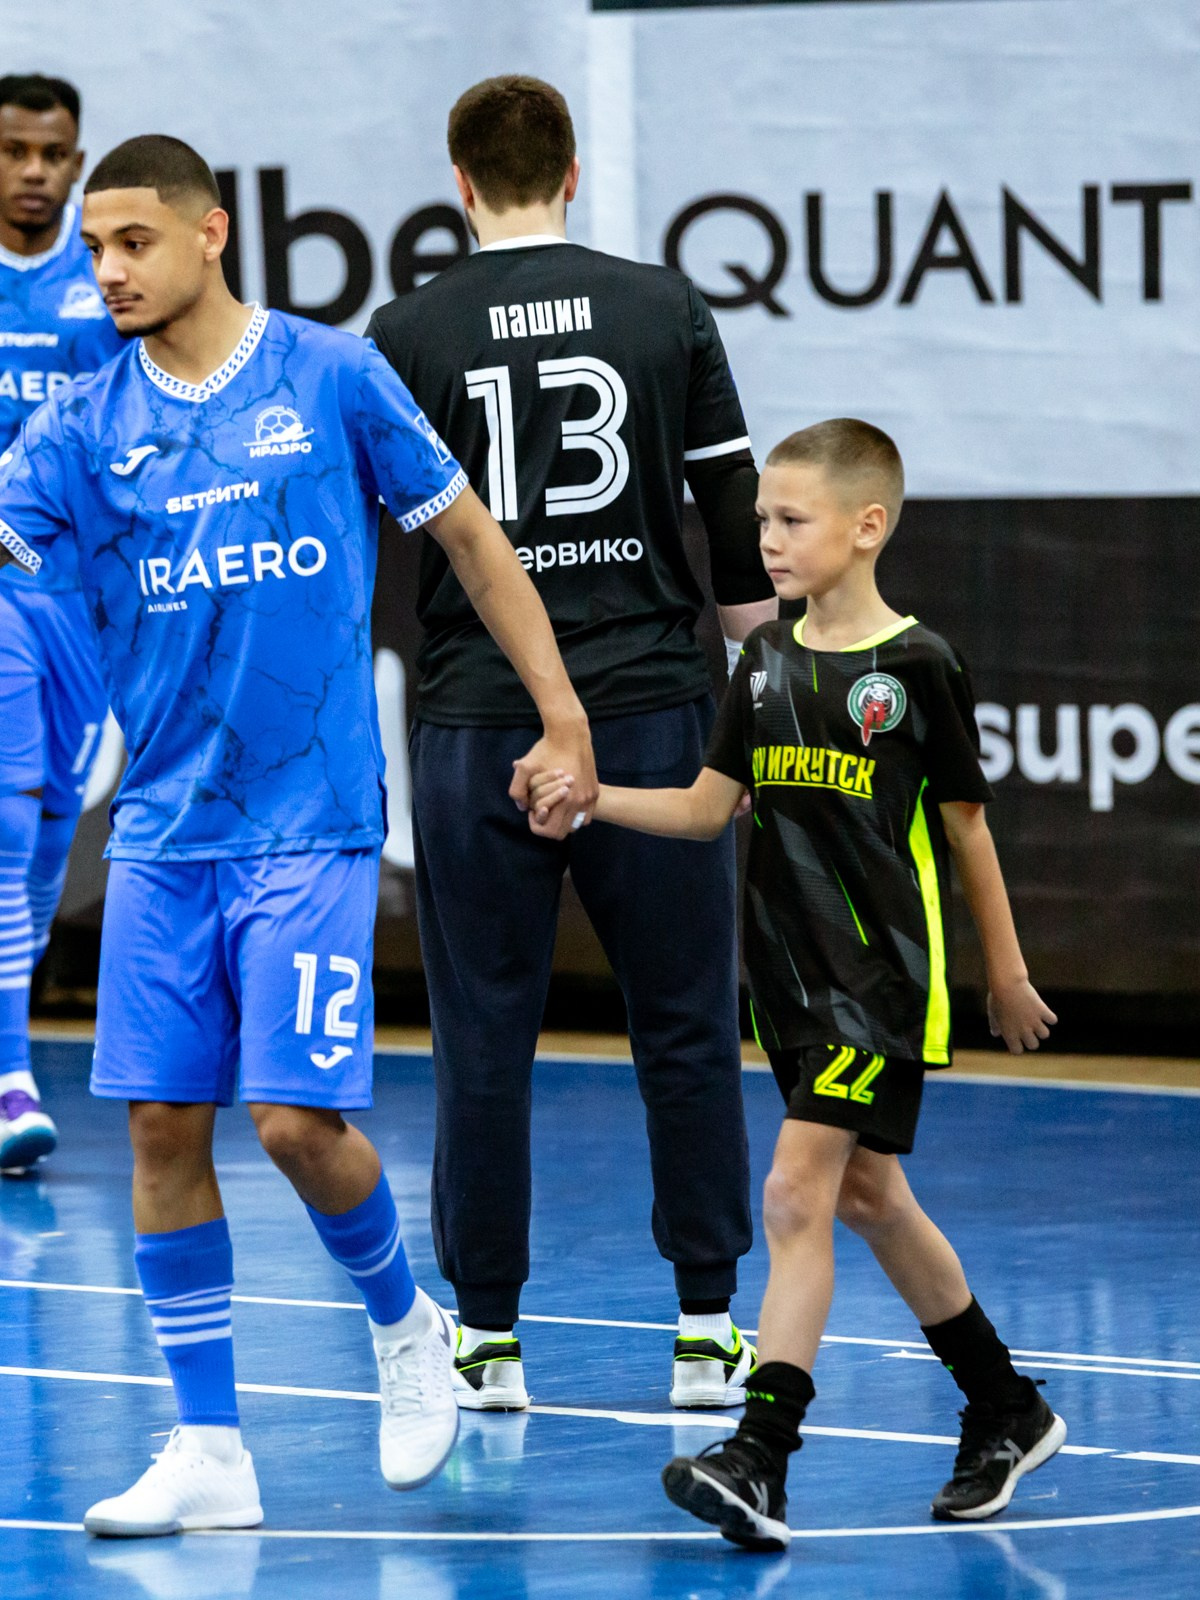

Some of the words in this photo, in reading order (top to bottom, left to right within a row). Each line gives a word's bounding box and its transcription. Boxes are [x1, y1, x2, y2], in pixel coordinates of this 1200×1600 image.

[661, 180, 1194, 318] QUANT
[249, 441, 312, 458] ИРАЭРО
[464, 355, 630, 522] 13
[165, 480, 260, 514] БЕТСИТИ
[138, 535, 327, 597] IRAERO
[767, 745, 877, 795] ИРКУТСК
[293, 951, 361, 1039] 12
[813, 1044, 886, 1105] 22
